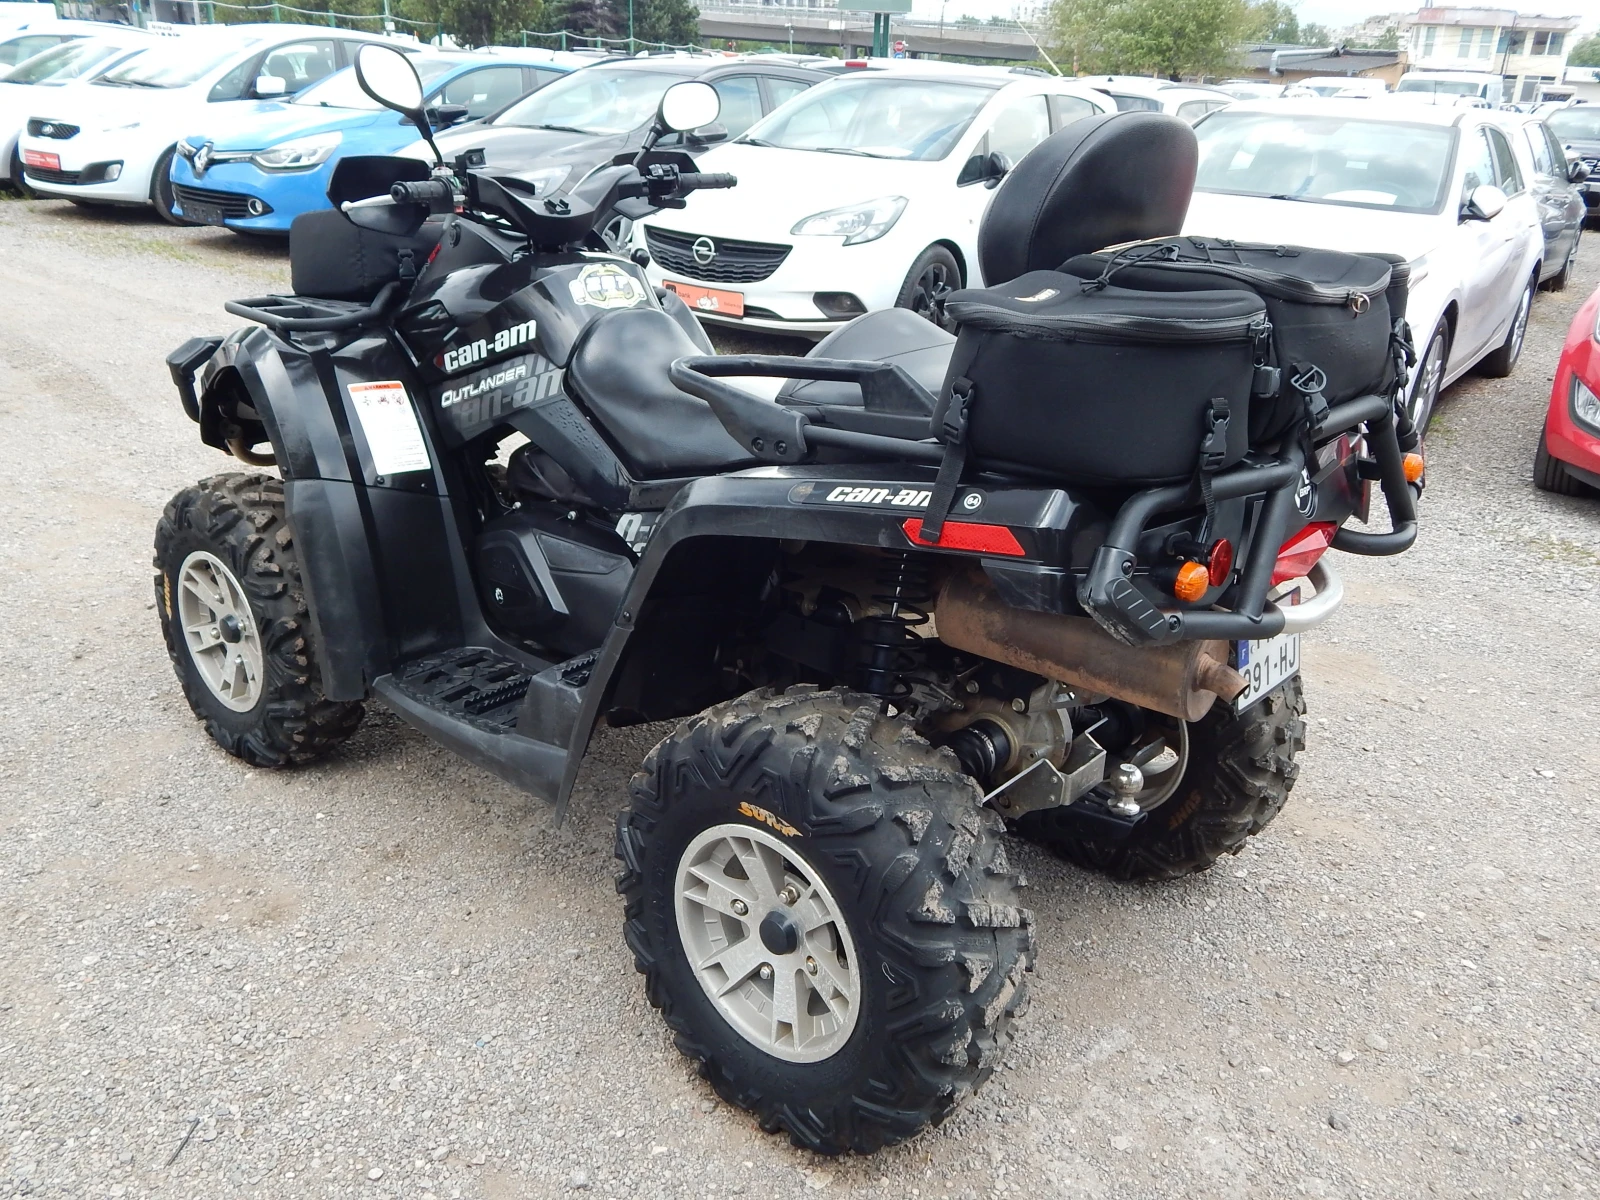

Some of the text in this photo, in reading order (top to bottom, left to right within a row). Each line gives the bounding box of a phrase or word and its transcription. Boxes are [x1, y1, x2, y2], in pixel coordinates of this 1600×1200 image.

[443, 319, 537, 372] can-am
[440, 363, 528, 408] OUTLANDER
[1299, 485, 1311, 497] BRP
